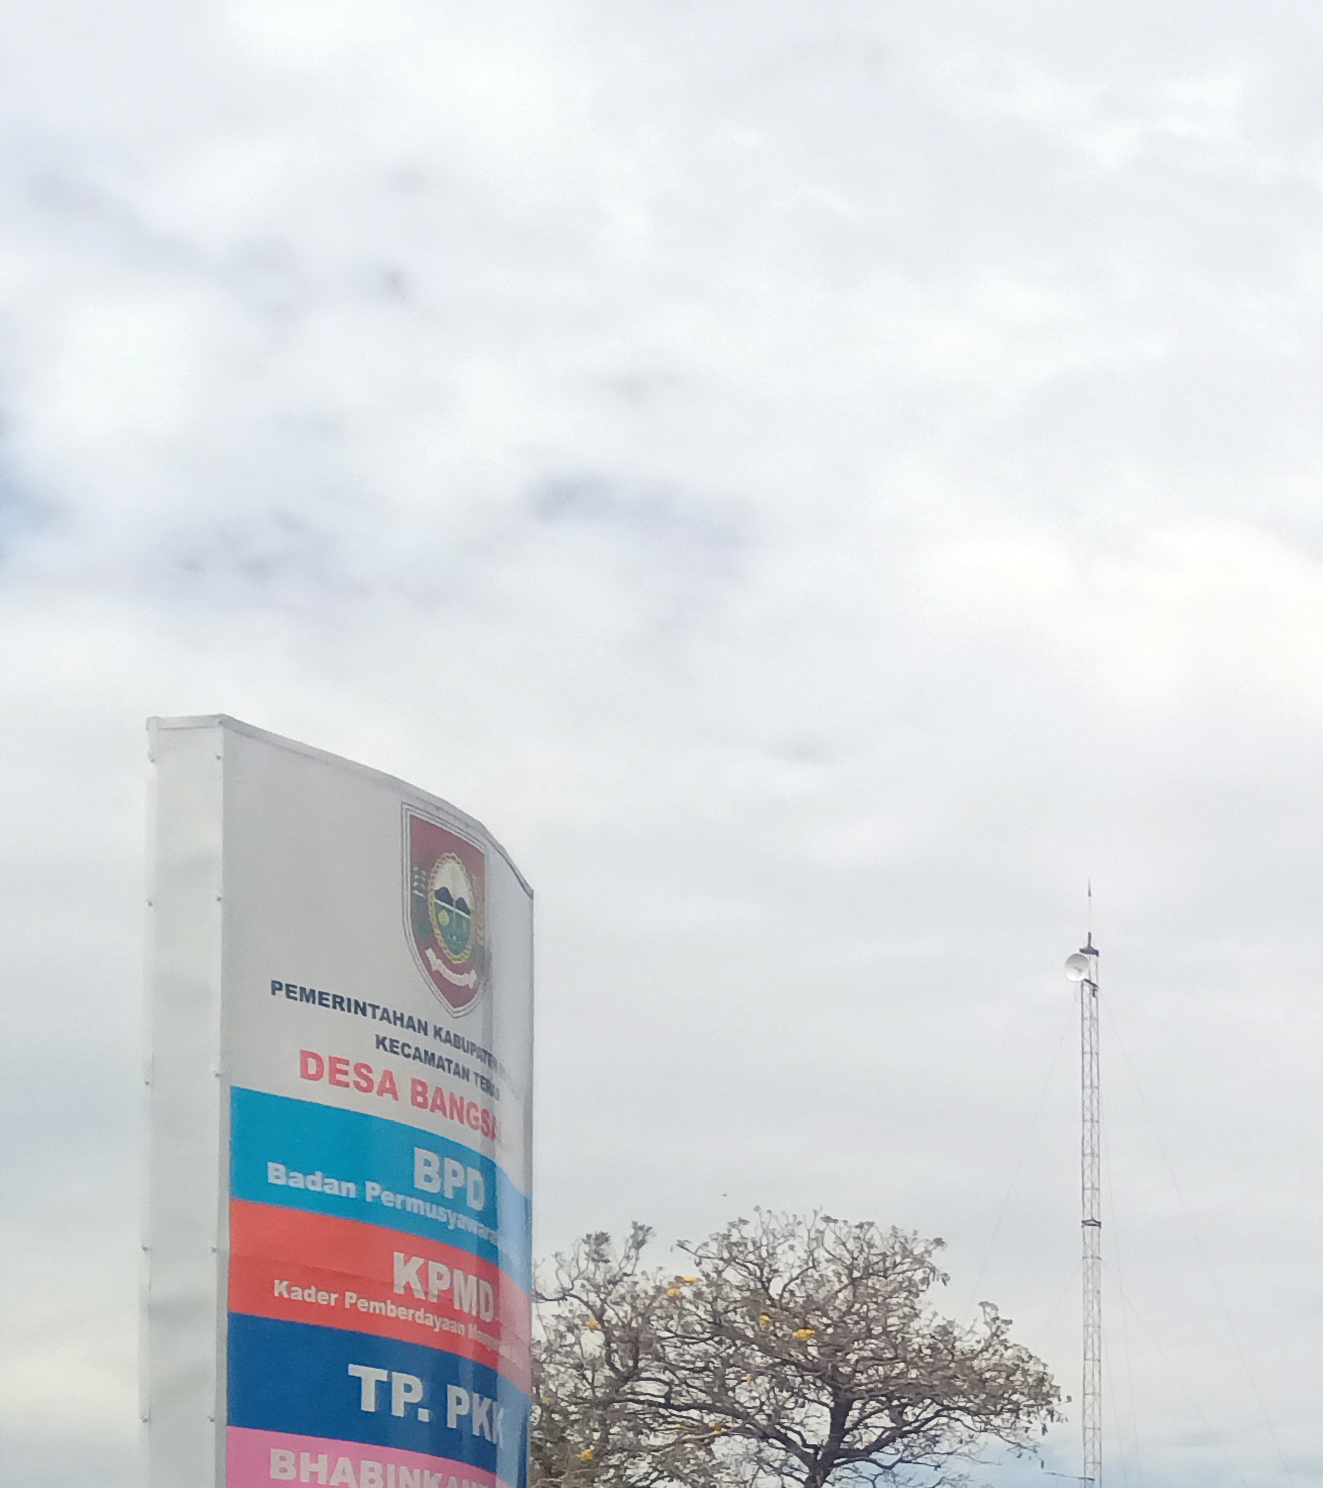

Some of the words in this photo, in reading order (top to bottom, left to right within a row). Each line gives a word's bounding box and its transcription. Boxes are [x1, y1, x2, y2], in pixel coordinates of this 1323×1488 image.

[270, 980, 428, 1036] PEMERINTAHAN
[300, 1050, 399, 1101] DESA
[375, 1034, 470, 1082] KECAMATAN
[267, 1161, 356, 1199] Badan
[414, 1147, 486, 1211] BPD
[274, 1279, 339, 1307] Kader
[345, 1292, 466, 1336] Pemberdayaan
[393, 1251, 495, 1322] KPMD
[348, 1364, 430, 1423] TP.
